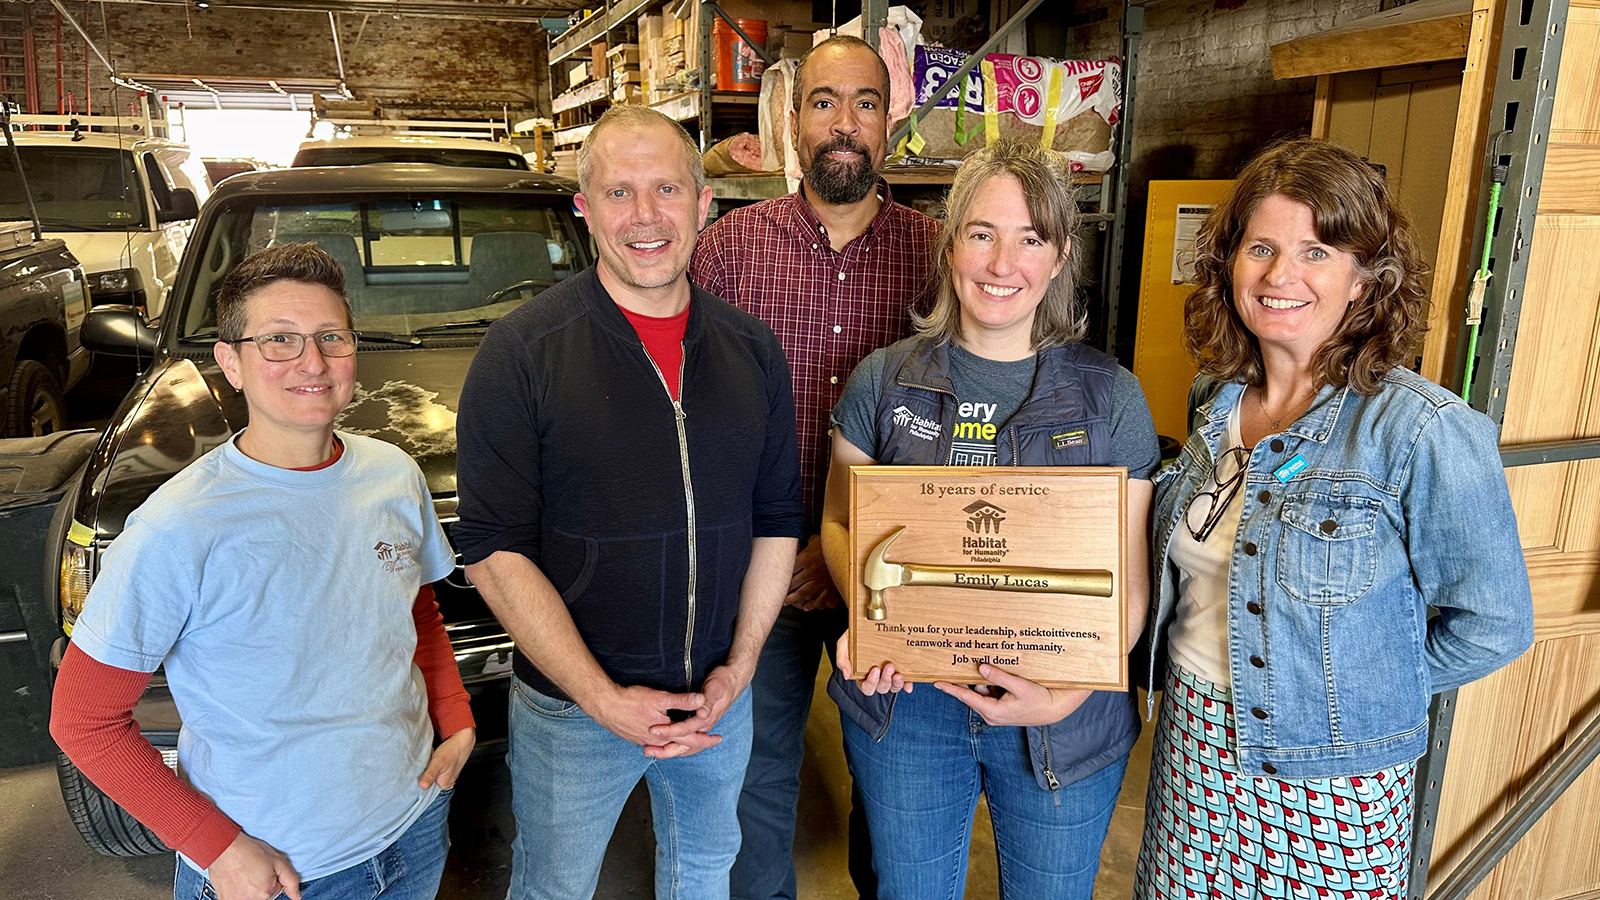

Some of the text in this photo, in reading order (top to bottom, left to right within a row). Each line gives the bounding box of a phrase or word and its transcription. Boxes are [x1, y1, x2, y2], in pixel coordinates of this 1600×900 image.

[958, 402, 997, 422] ery
[920, 482, 1050, 498] 18 years of service
[962, 536, 1007, 549] Habitat
[954, 572, 1049, 589] Emily Lucas
[875, 623, 1101, 640] Thank you for your leadership, sticktoittiveness,
[906, 639, 1066, 654] teamwork and heart for humanity.
[952, 654, 1020, 665] Job well done!
